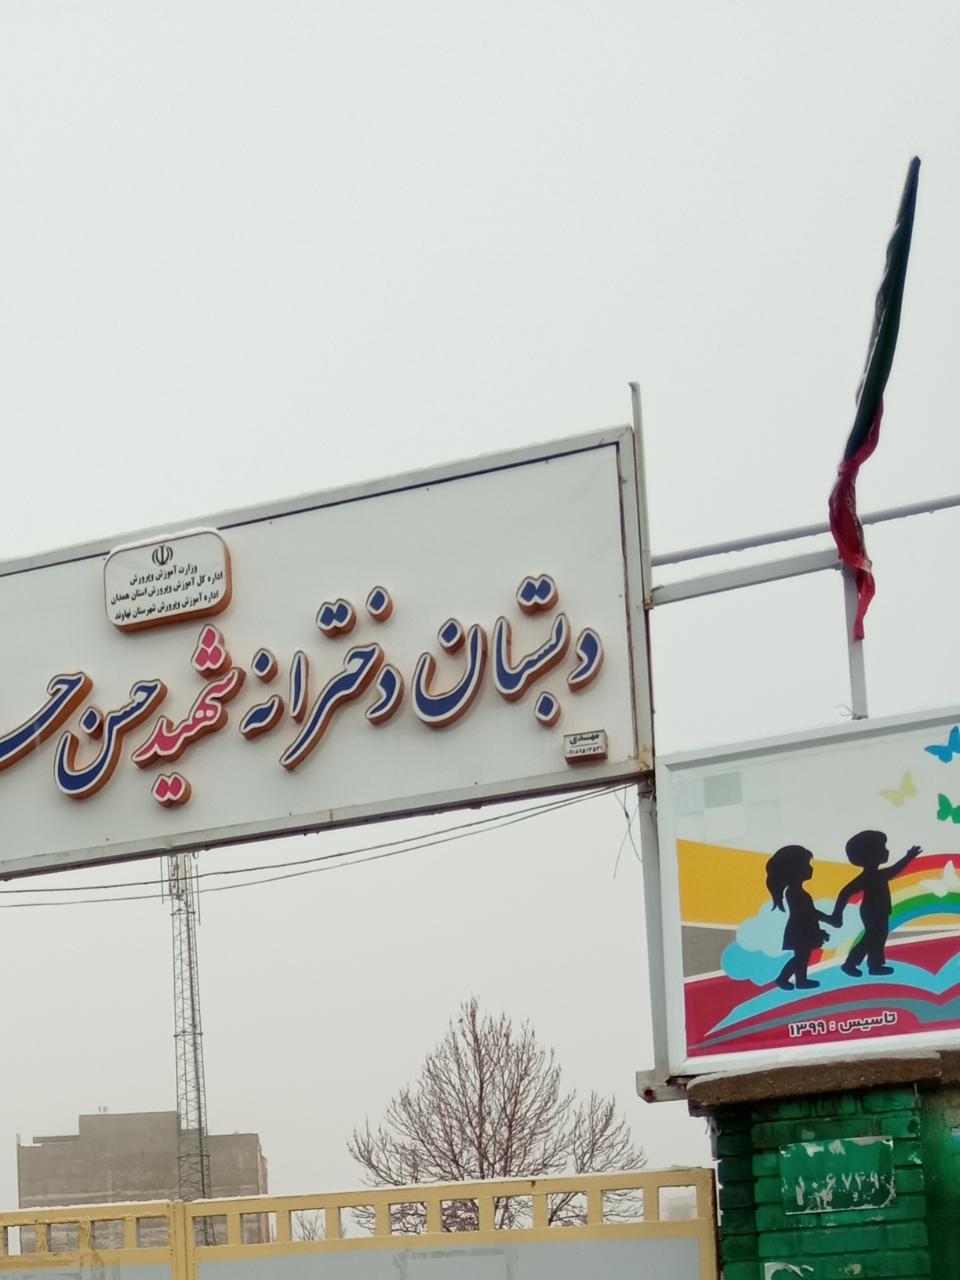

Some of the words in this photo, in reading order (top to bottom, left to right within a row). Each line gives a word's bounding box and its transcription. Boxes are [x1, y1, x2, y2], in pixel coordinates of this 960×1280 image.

[155, 565, 177, 581] آموزش
[178, 564, 198, 575] وزارت
[173, 577, 195, 592] آموزش
[196, 575, 207, 587] کل
[207, 570, 223, 585] اداره
[110, 592, 130, 605] همدان
[131, 587, 148, 601] استان
[181, 593, 202, 607] آموزش
[203, 590, 219, 603] اداره
[114, 610, 132, 621] نهاوند
[133, 604, 157, 618] شهرستان
[410, 573, 605, 730] دبستان
[240, 585, 404, 770] دخترانه
[131, 623, 243, 805] شهید
[54, 678, 165, 798] حسن
[789, 1021, 826, 1037] ۱۳۹۹
